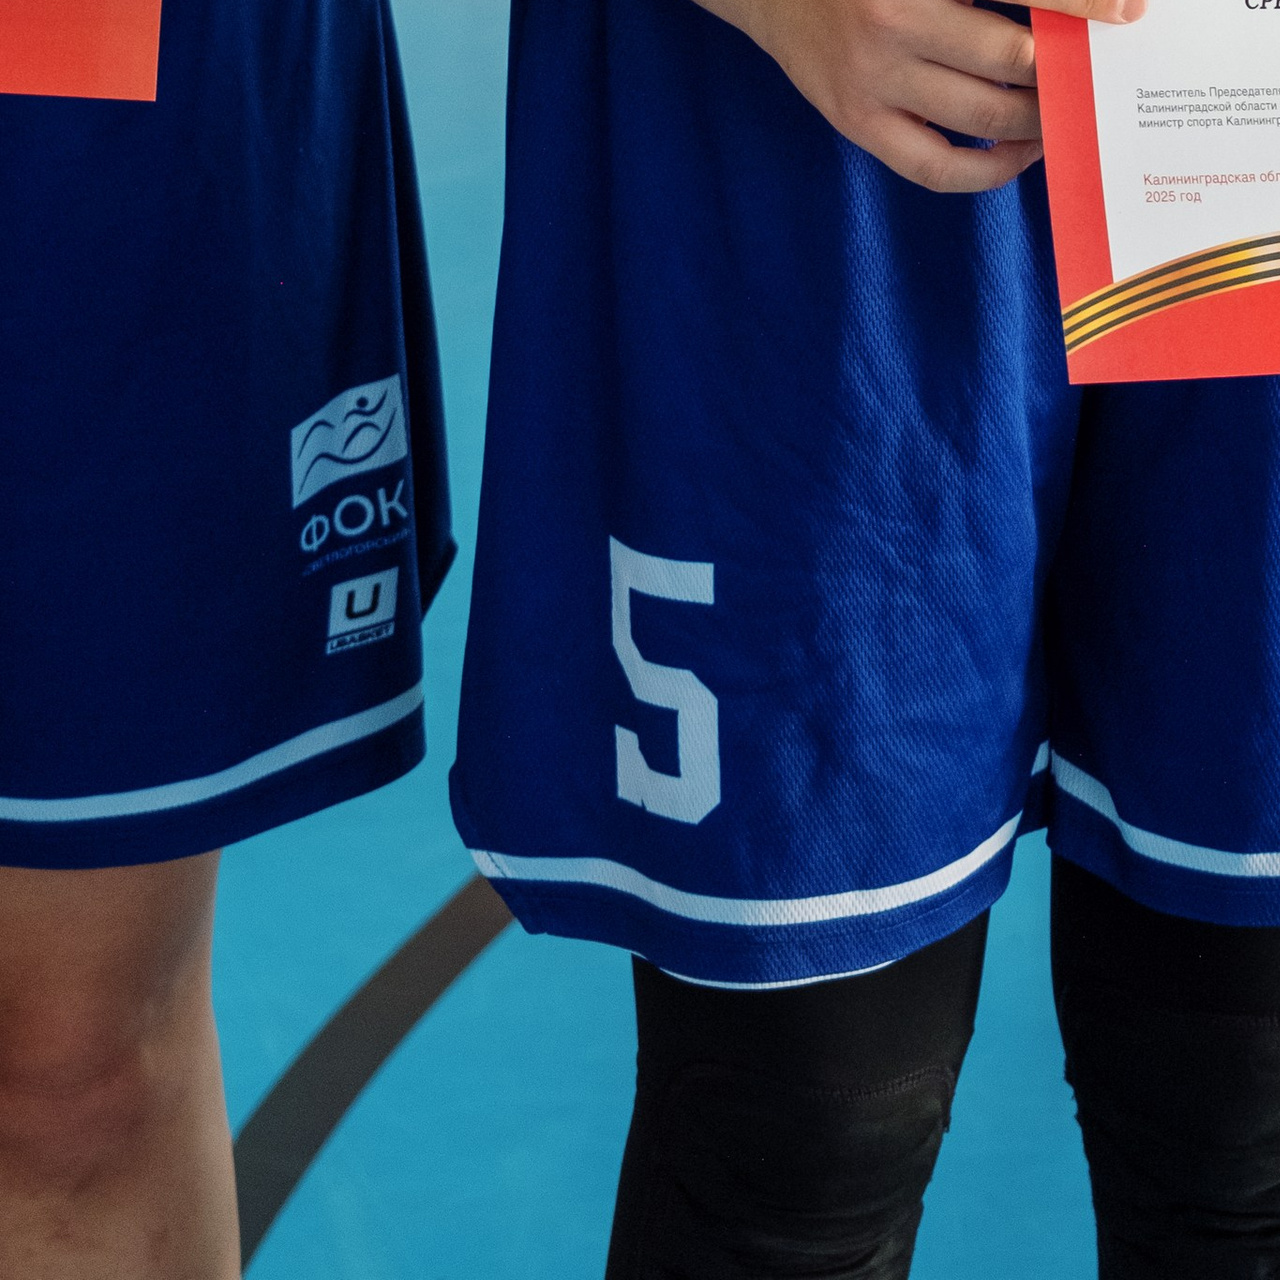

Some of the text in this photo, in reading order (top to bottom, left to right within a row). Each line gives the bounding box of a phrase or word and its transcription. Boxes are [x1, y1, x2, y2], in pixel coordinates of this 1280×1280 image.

[1136, 88, 1207, 99] Заместитель
[1137, 102, 1232, 115] Калининградской
[1235, 101, 1278, 112] области
[1138, 117, 1184, 130] министр
[1187, 117, 1223, 129] спорта
[1143, 172, 1256, 187] Калининградская
[1145, 191, 1202, 203] 2025 год
[301, 478, 409, 552] ФОК
[609, 535, 721, 825] 5
